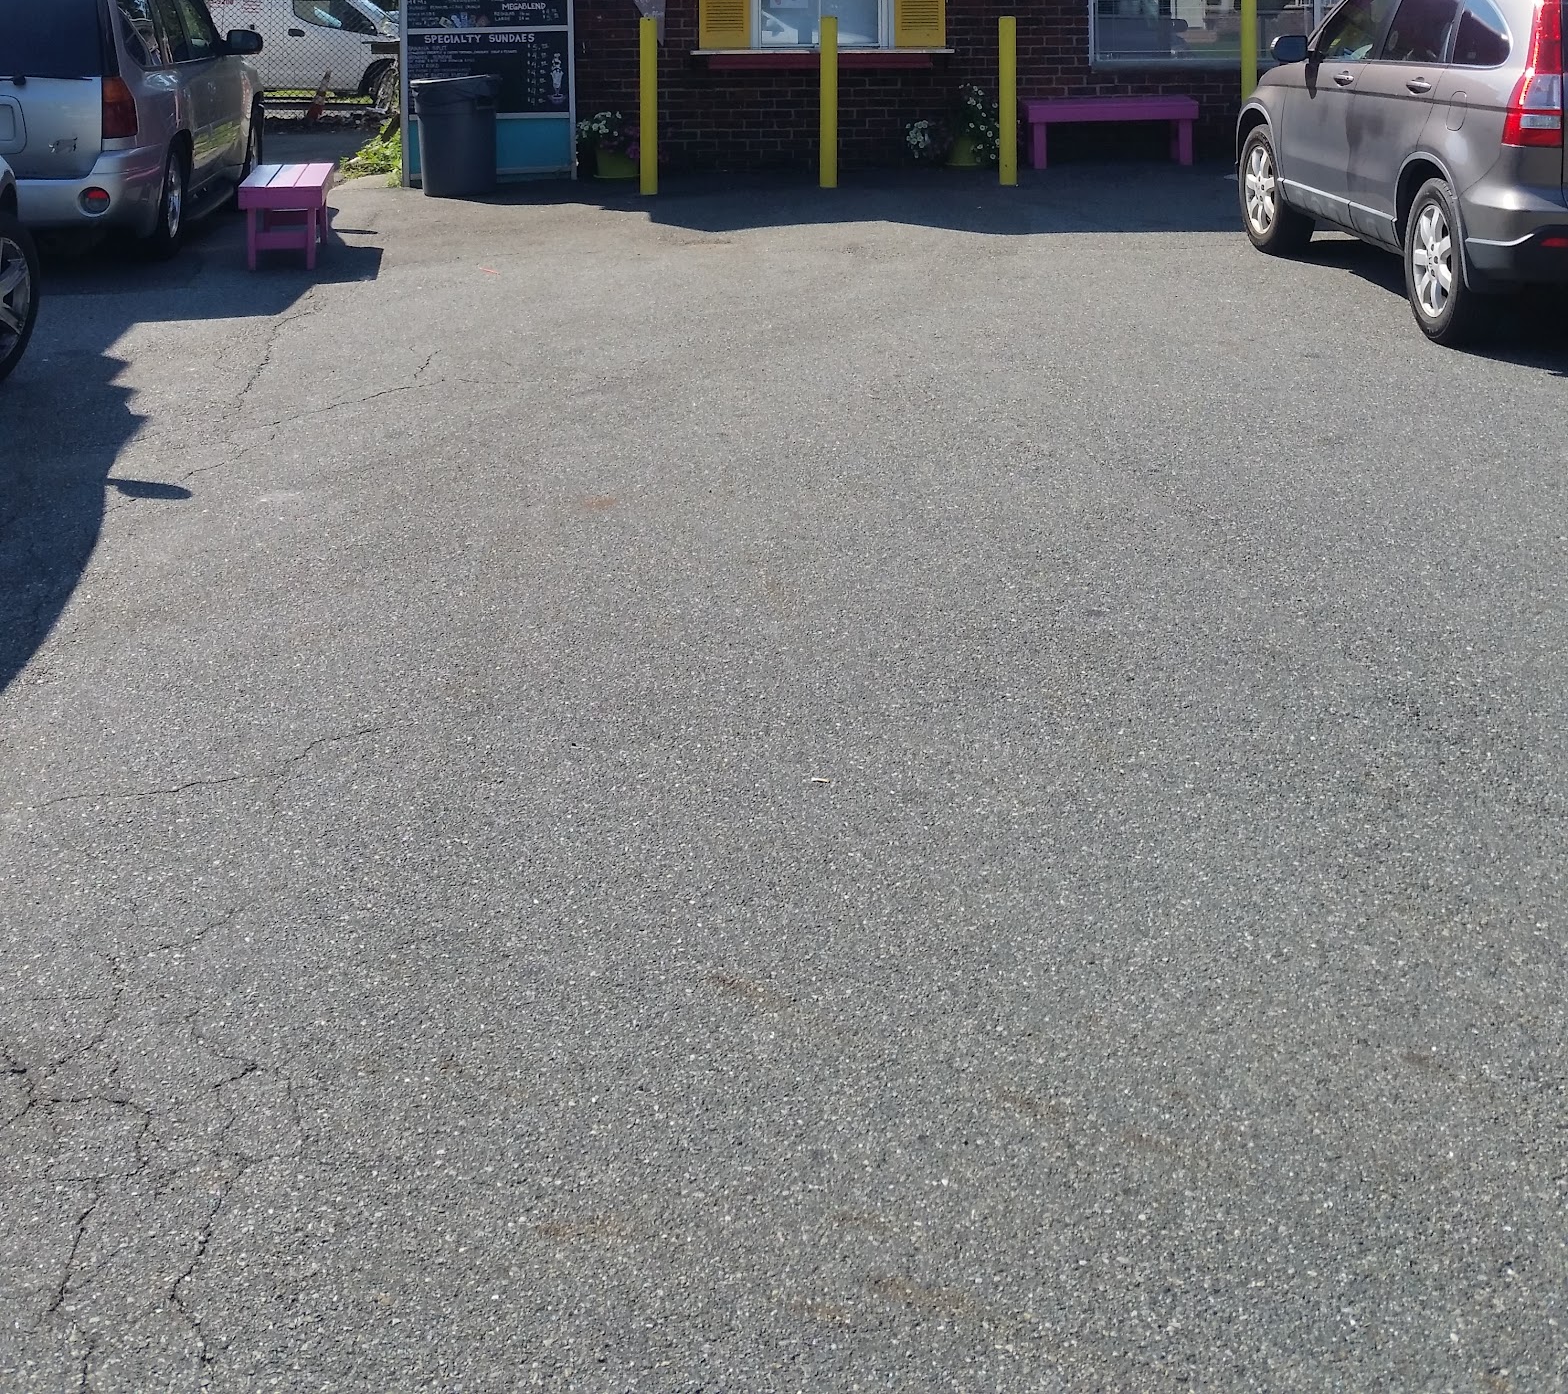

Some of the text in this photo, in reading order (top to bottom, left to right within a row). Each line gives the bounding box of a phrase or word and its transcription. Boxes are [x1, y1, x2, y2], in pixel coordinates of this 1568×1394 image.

[502, 2, 547, 10] MEGABLEND
[424, 33, 536, 44] SPECIALTY SUNDAES
